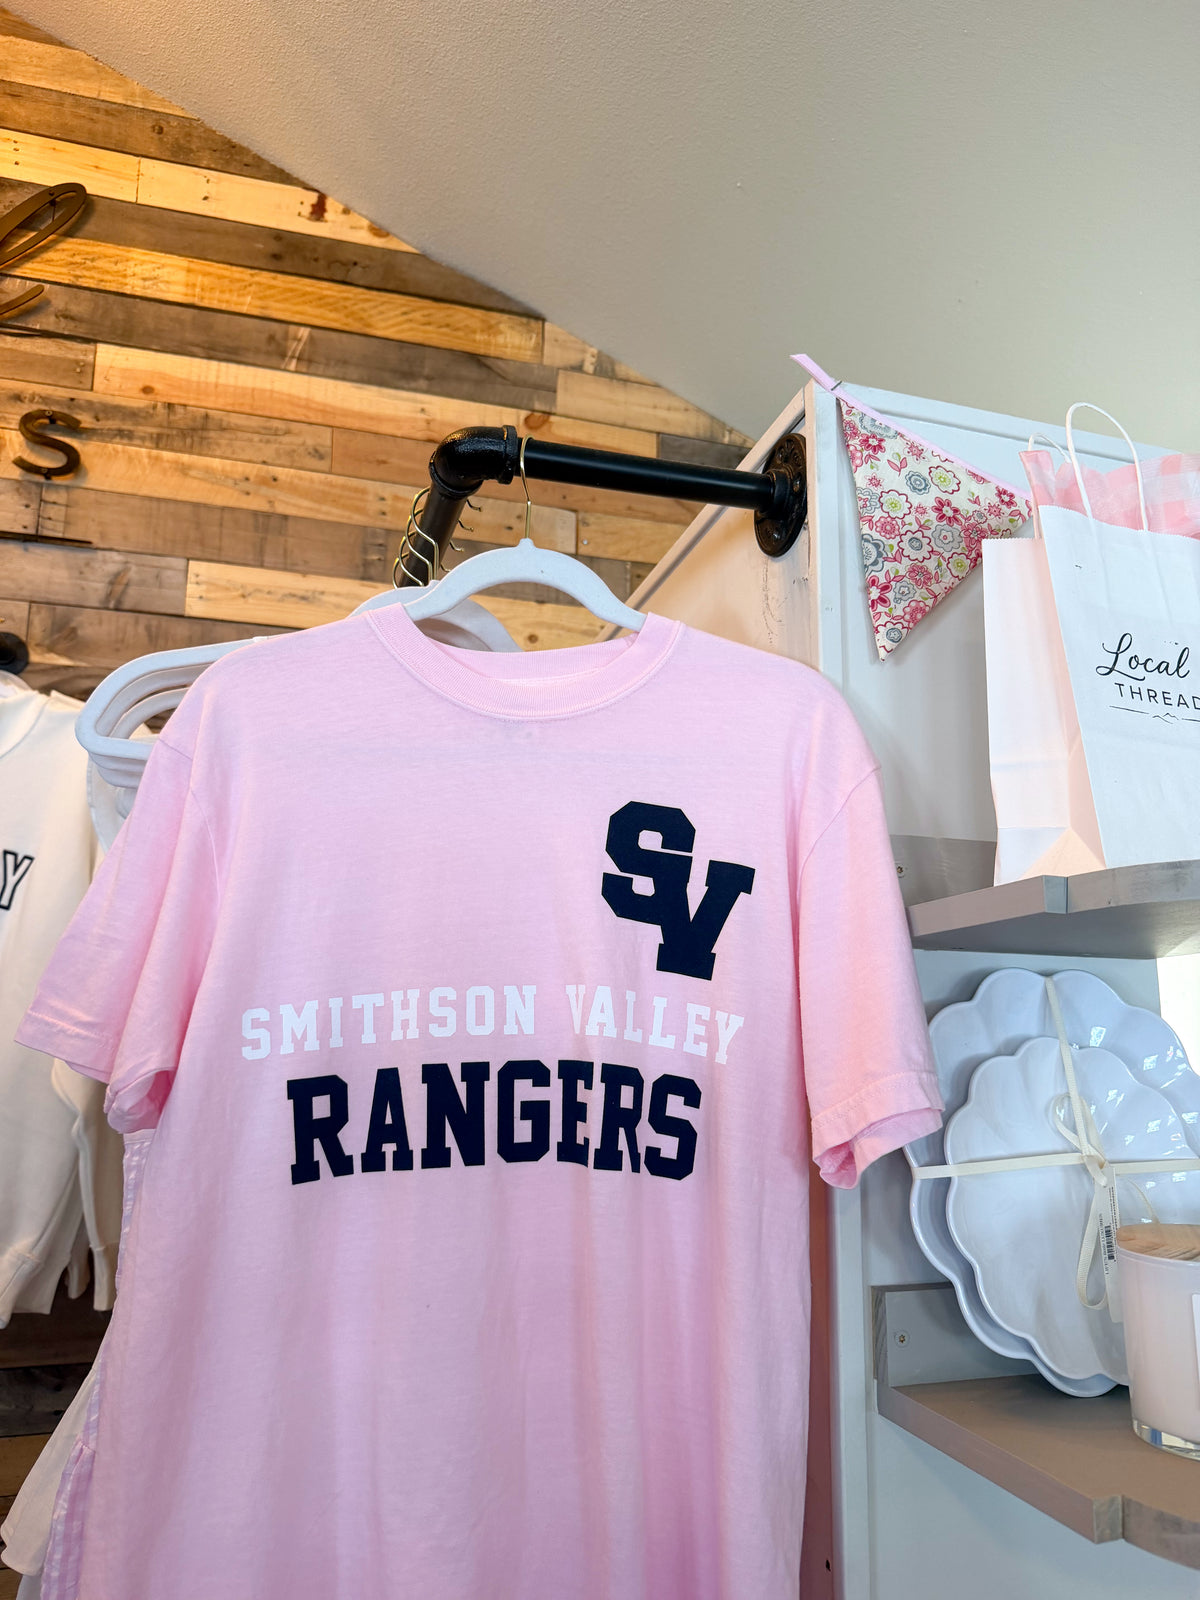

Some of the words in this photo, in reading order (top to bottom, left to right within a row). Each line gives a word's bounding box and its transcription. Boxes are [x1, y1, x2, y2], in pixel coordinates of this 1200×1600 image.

[1096, 632, 1190, 681] Local
[0, 849, 35, 911] Y
[601, 801, 756, 981] SV
[241, 985, 537, 1060] SMITHSON
[565, 985, 744, 1065] VALLEY
[286, 1059, 702, 1186] RANGERS
